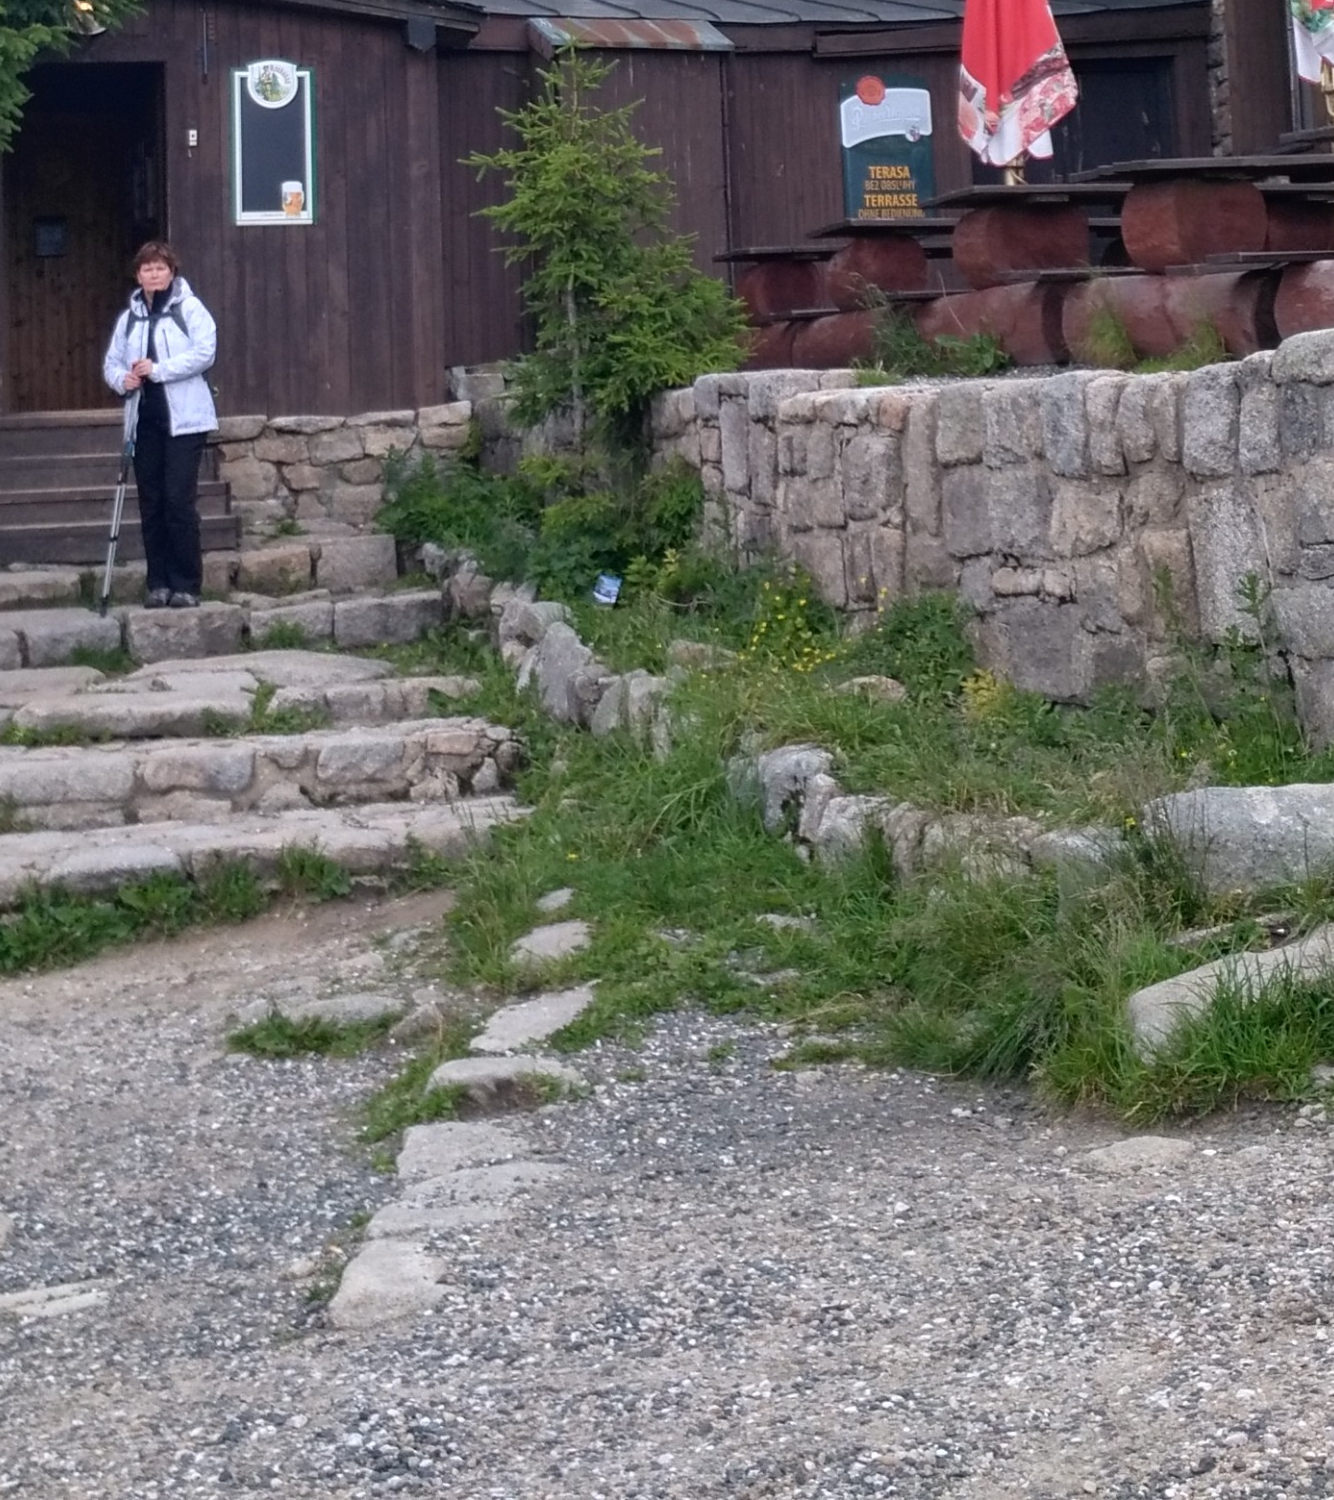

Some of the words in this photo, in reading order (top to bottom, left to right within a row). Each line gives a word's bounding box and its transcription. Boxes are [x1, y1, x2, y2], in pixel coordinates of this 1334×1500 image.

[868, 165, 911, 179] TERASA
[864, 180, 880, 191] BEZ
[864, 194, 918, 208] TERRASSE
[858, 208, 880, 219] OHNE
